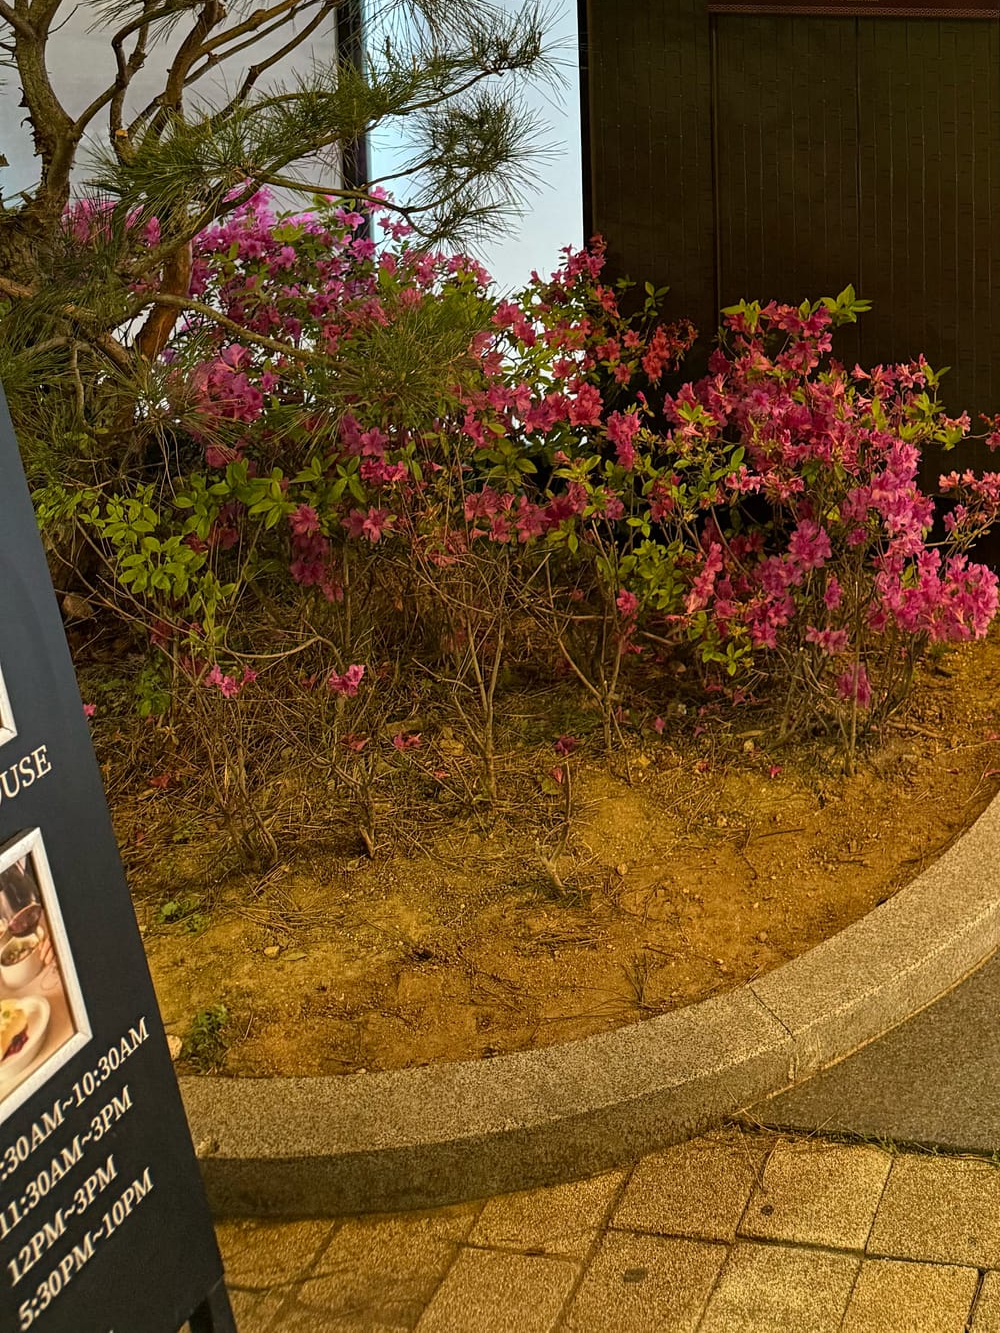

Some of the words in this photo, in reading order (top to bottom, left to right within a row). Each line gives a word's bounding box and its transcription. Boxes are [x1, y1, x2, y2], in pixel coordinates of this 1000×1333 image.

[0, 744, 52, 805] USE
[0, 1016, 150, 1181] :30AM~10:30AM
[7, 1154, 118, 1287] 12PM~3PM
[18, 1167, 154, 1332] 5:30PM~10PM
